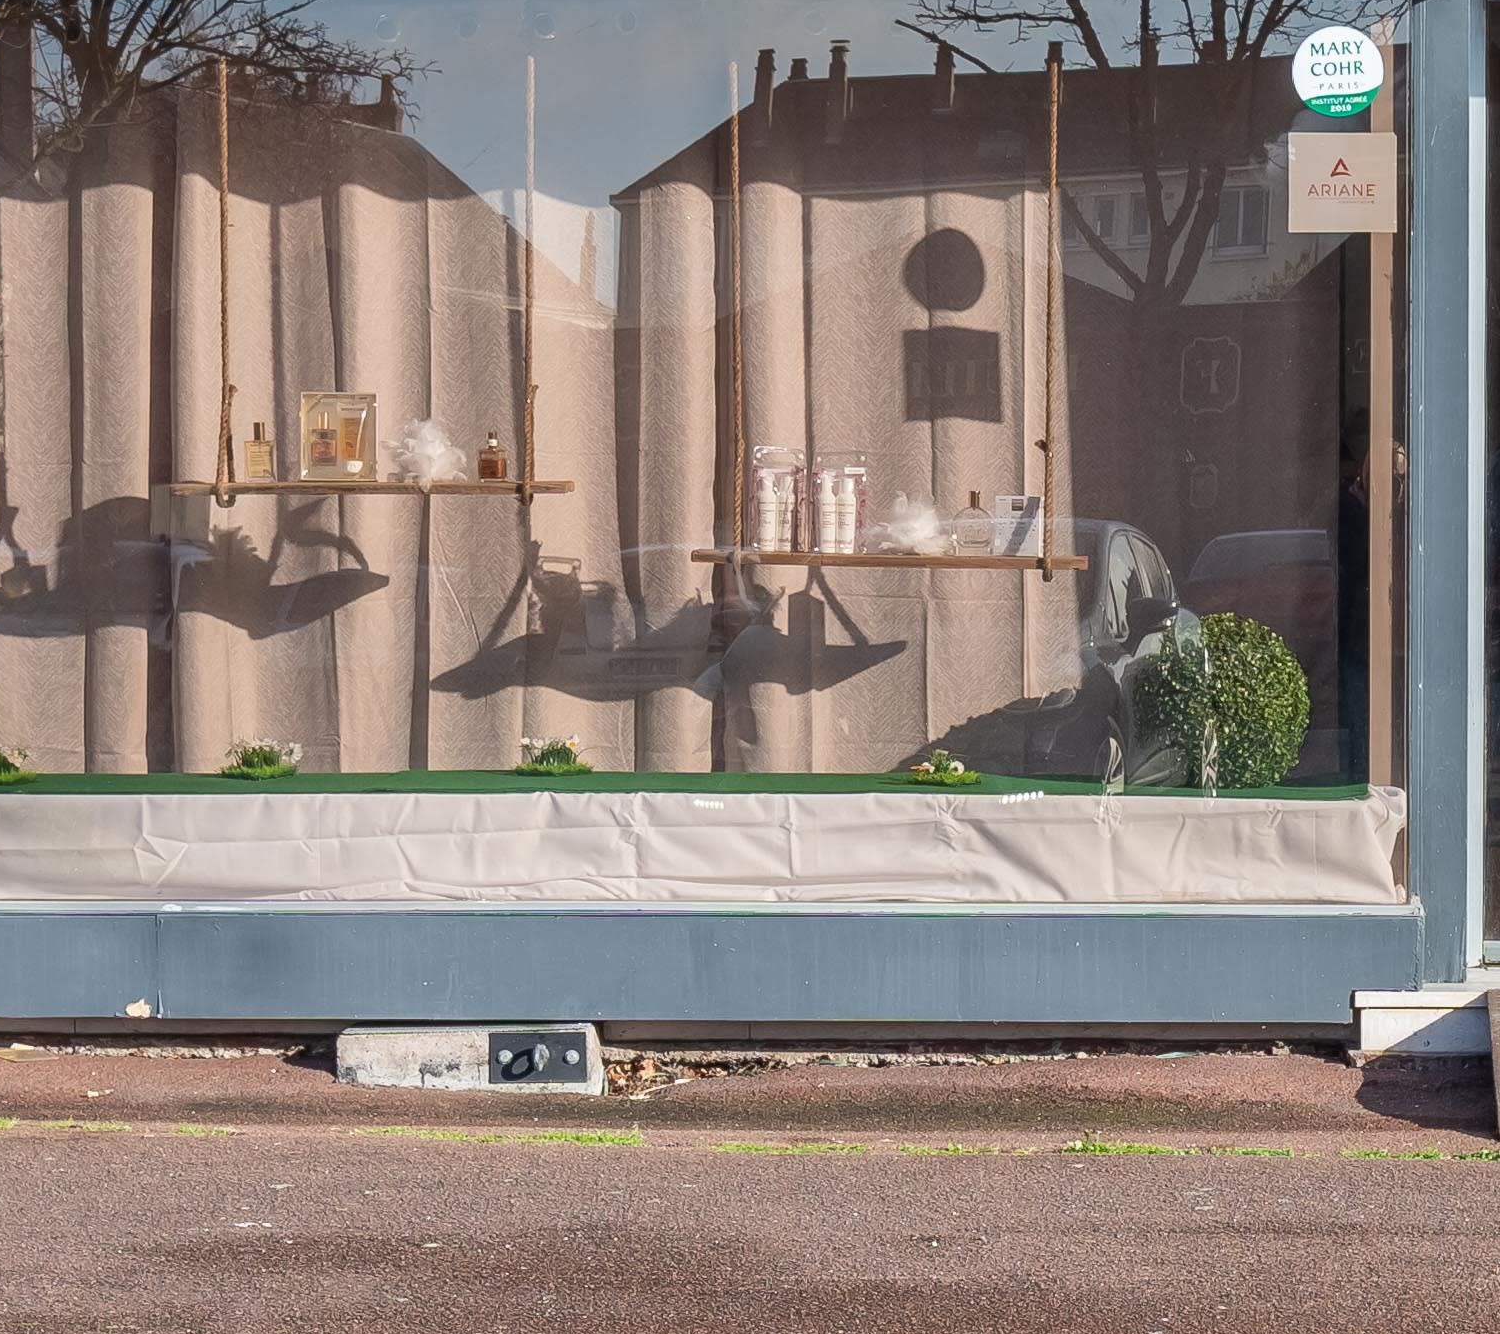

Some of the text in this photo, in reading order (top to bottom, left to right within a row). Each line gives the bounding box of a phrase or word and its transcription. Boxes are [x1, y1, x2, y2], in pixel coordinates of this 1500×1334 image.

[1310, 40, 1364, 57] MARY
[1310, 60, 1365, 77] COHR
[1319, 81, 1360, 91] PARIS
[1310, 97, 1344, 105] INSTITUT
[1307, 183, 1377, 197] ARIANE
